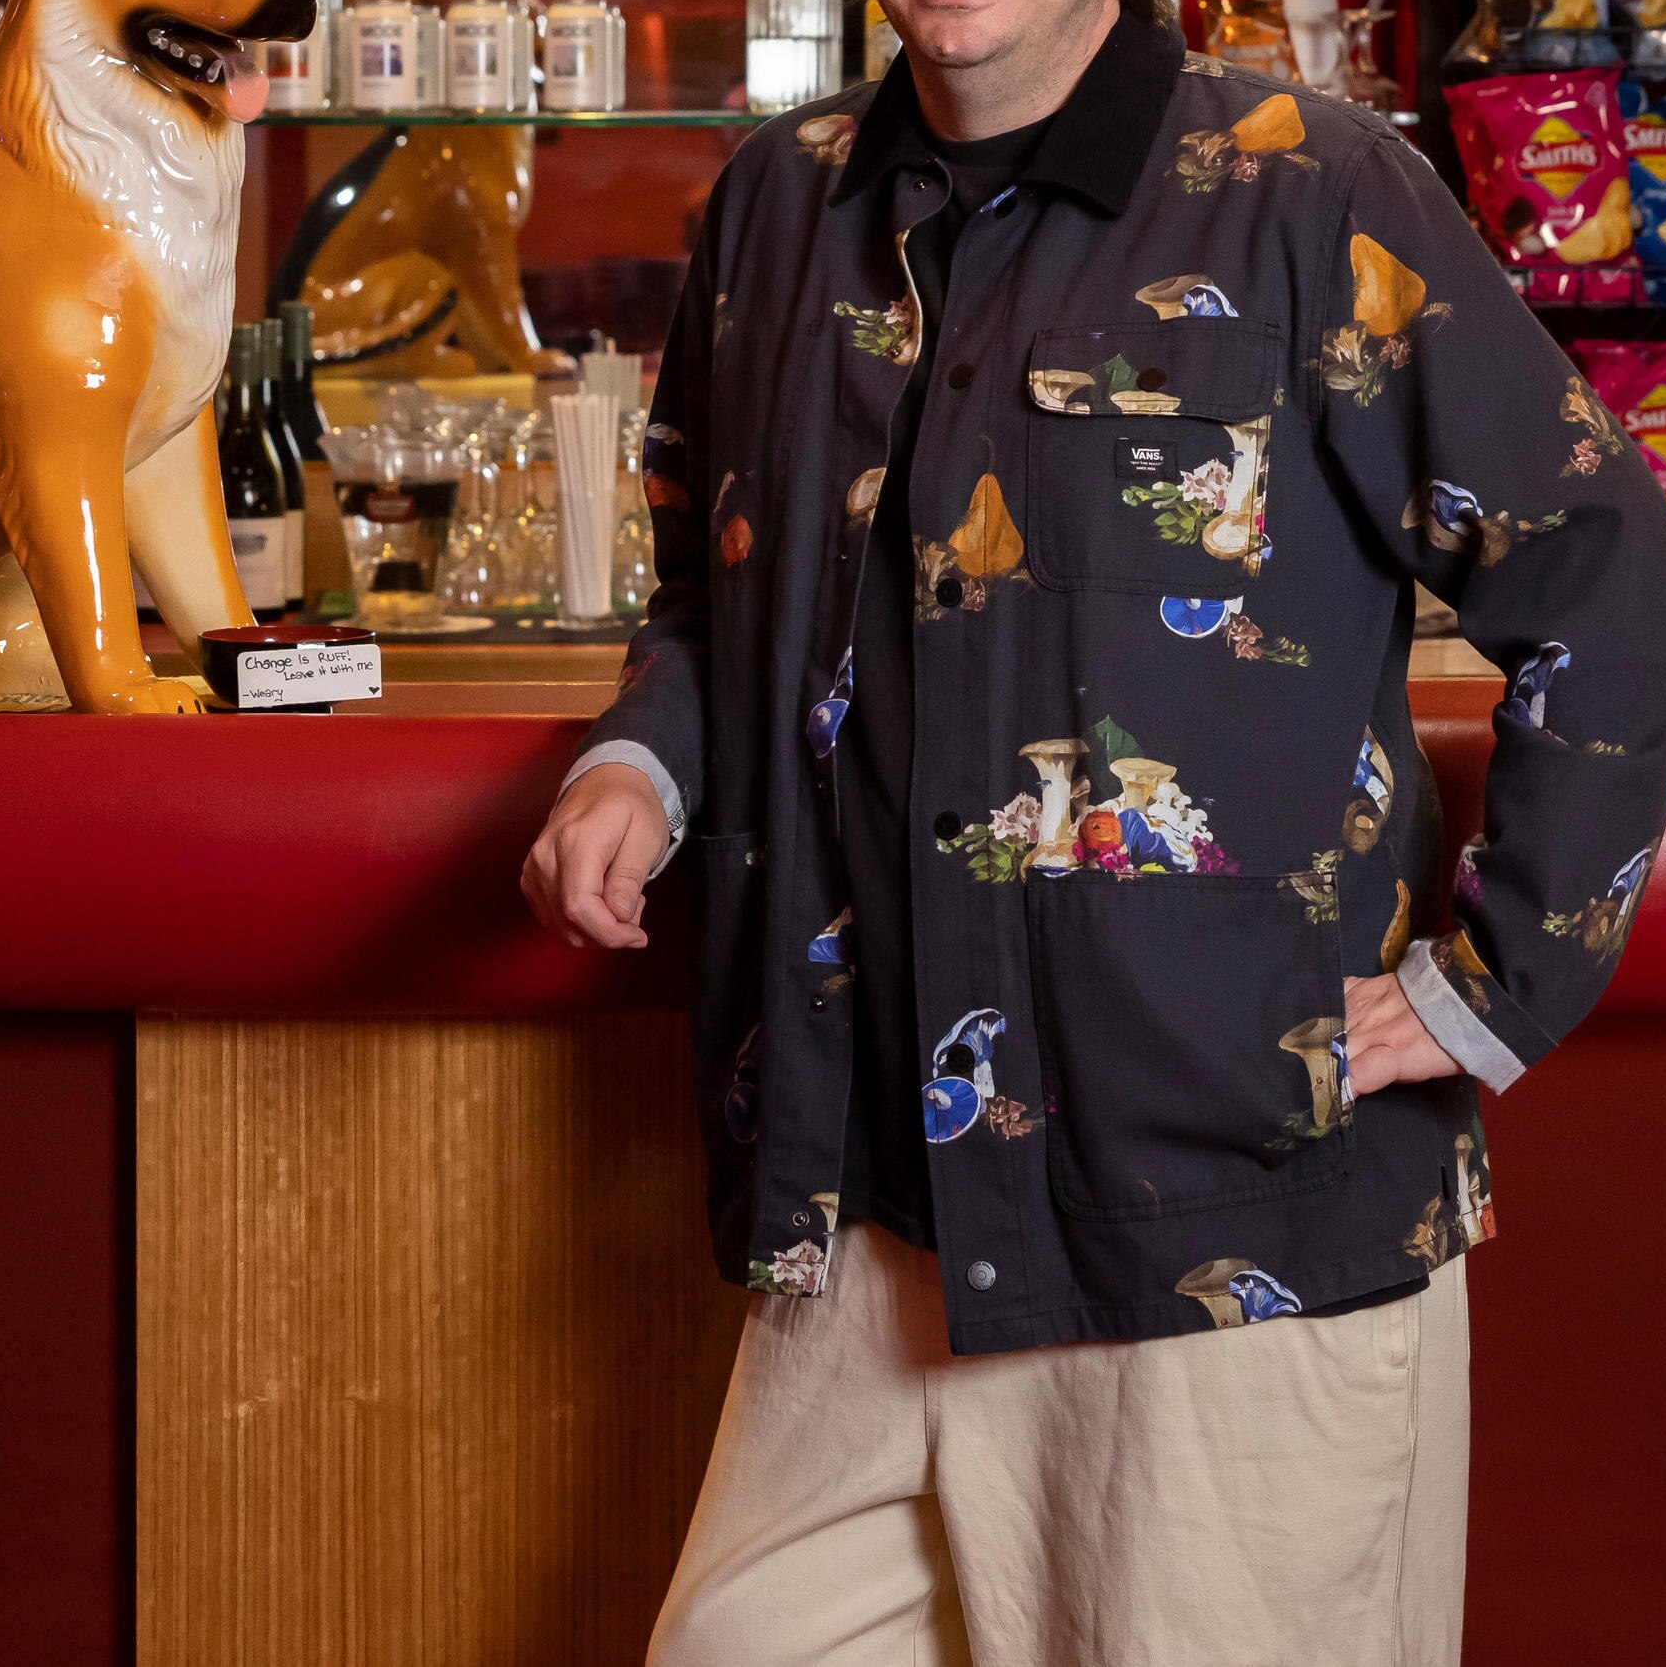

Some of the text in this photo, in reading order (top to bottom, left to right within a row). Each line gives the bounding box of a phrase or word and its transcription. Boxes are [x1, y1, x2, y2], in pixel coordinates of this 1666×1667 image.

[361, 25, 402, 38] MODE
[454, 25, 495, 38] MODE
[1131, 448, 1161, 460] VANS
[244, 650, 352, 674] Change is RUFF!
[283, 670, 315, 681] Leave
[357, 661, 374, 671] me
